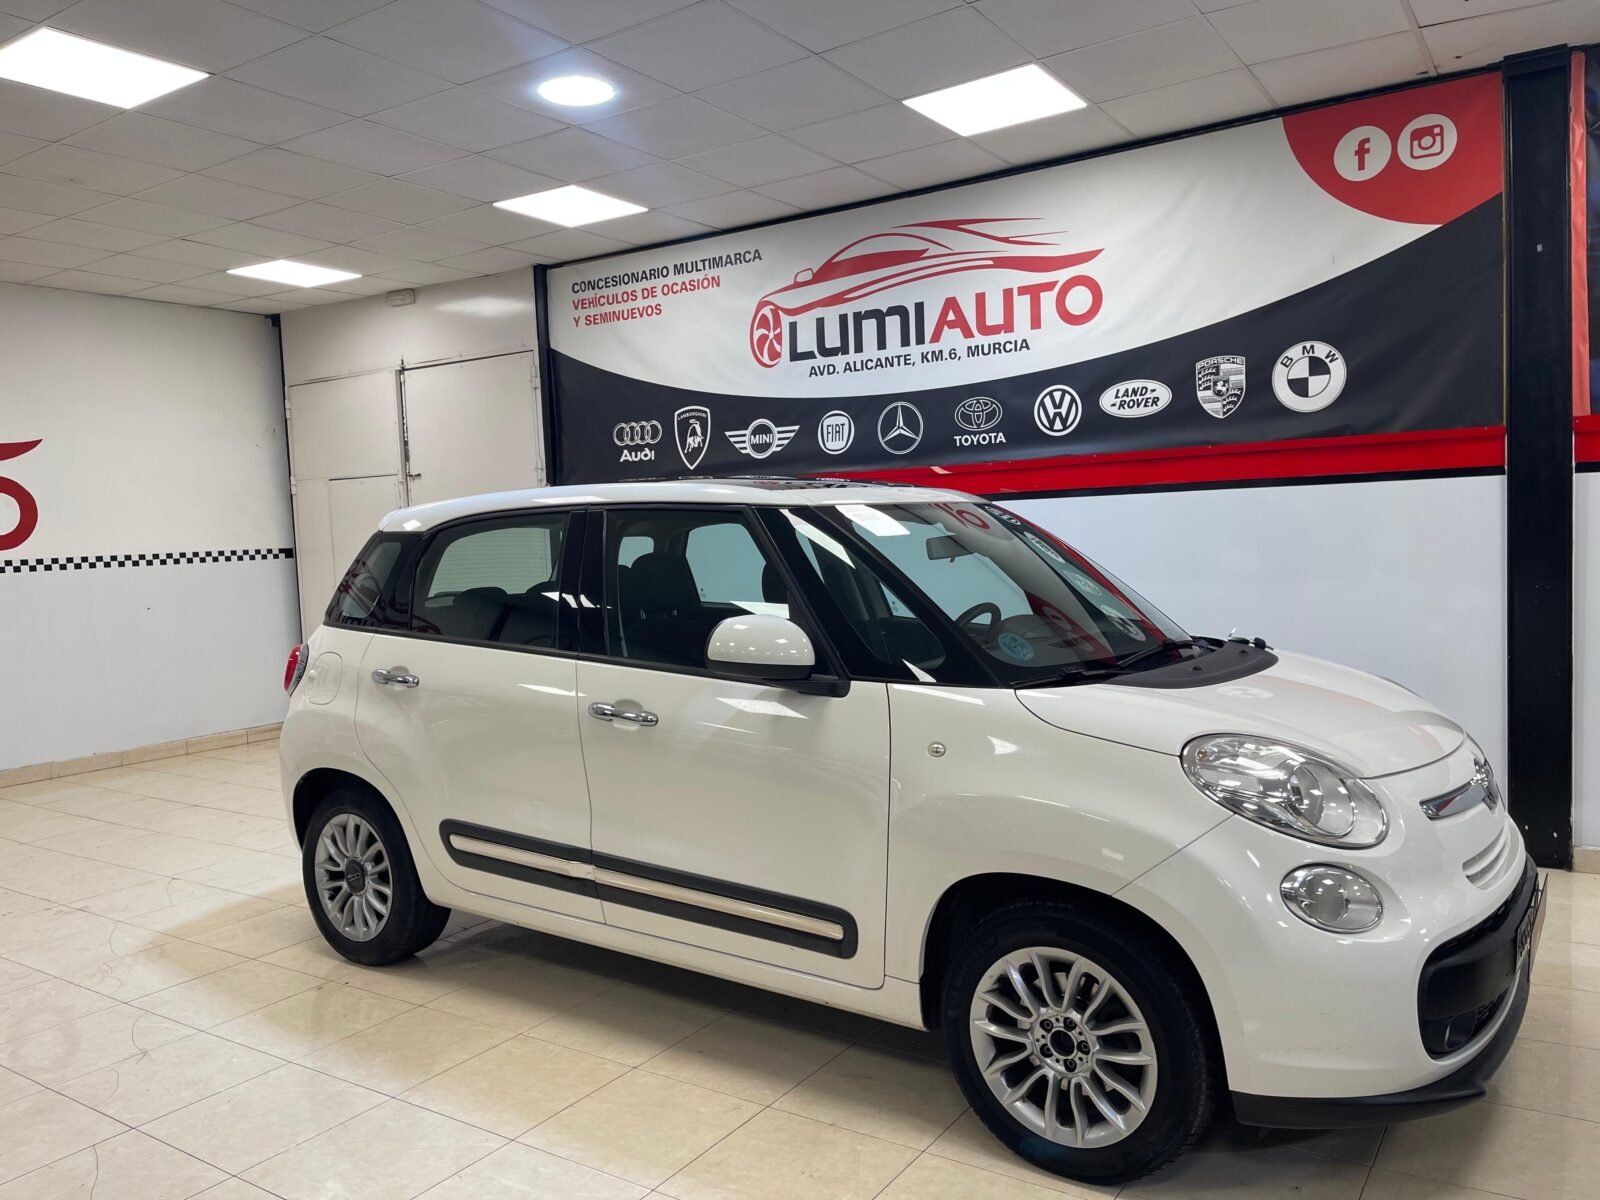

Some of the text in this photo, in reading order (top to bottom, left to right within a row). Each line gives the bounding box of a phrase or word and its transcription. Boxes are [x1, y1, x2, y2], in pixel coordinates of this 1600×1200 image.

[571, 249, 762, 294] CONCESIONARIO MULTIMARCA
[572, 274, 721, 311] VEHÍCULOS DE OCASIÓN
[573, 303, 662, 328] Y SEMINUEVOS
[808, 338, 1031, 377] AVD. ALICANTE, KM.6, MURCIA
[1197, 357, 1245, 369] PORSCHE
[1280, 344, 1339, 369] BMW
[750, 433, 773, 445] MINI
[826, 422, 846, 444] FIAT
[953, 432, 1006, 447] TOYOTA
[619, 447, 655, 463] Audi
